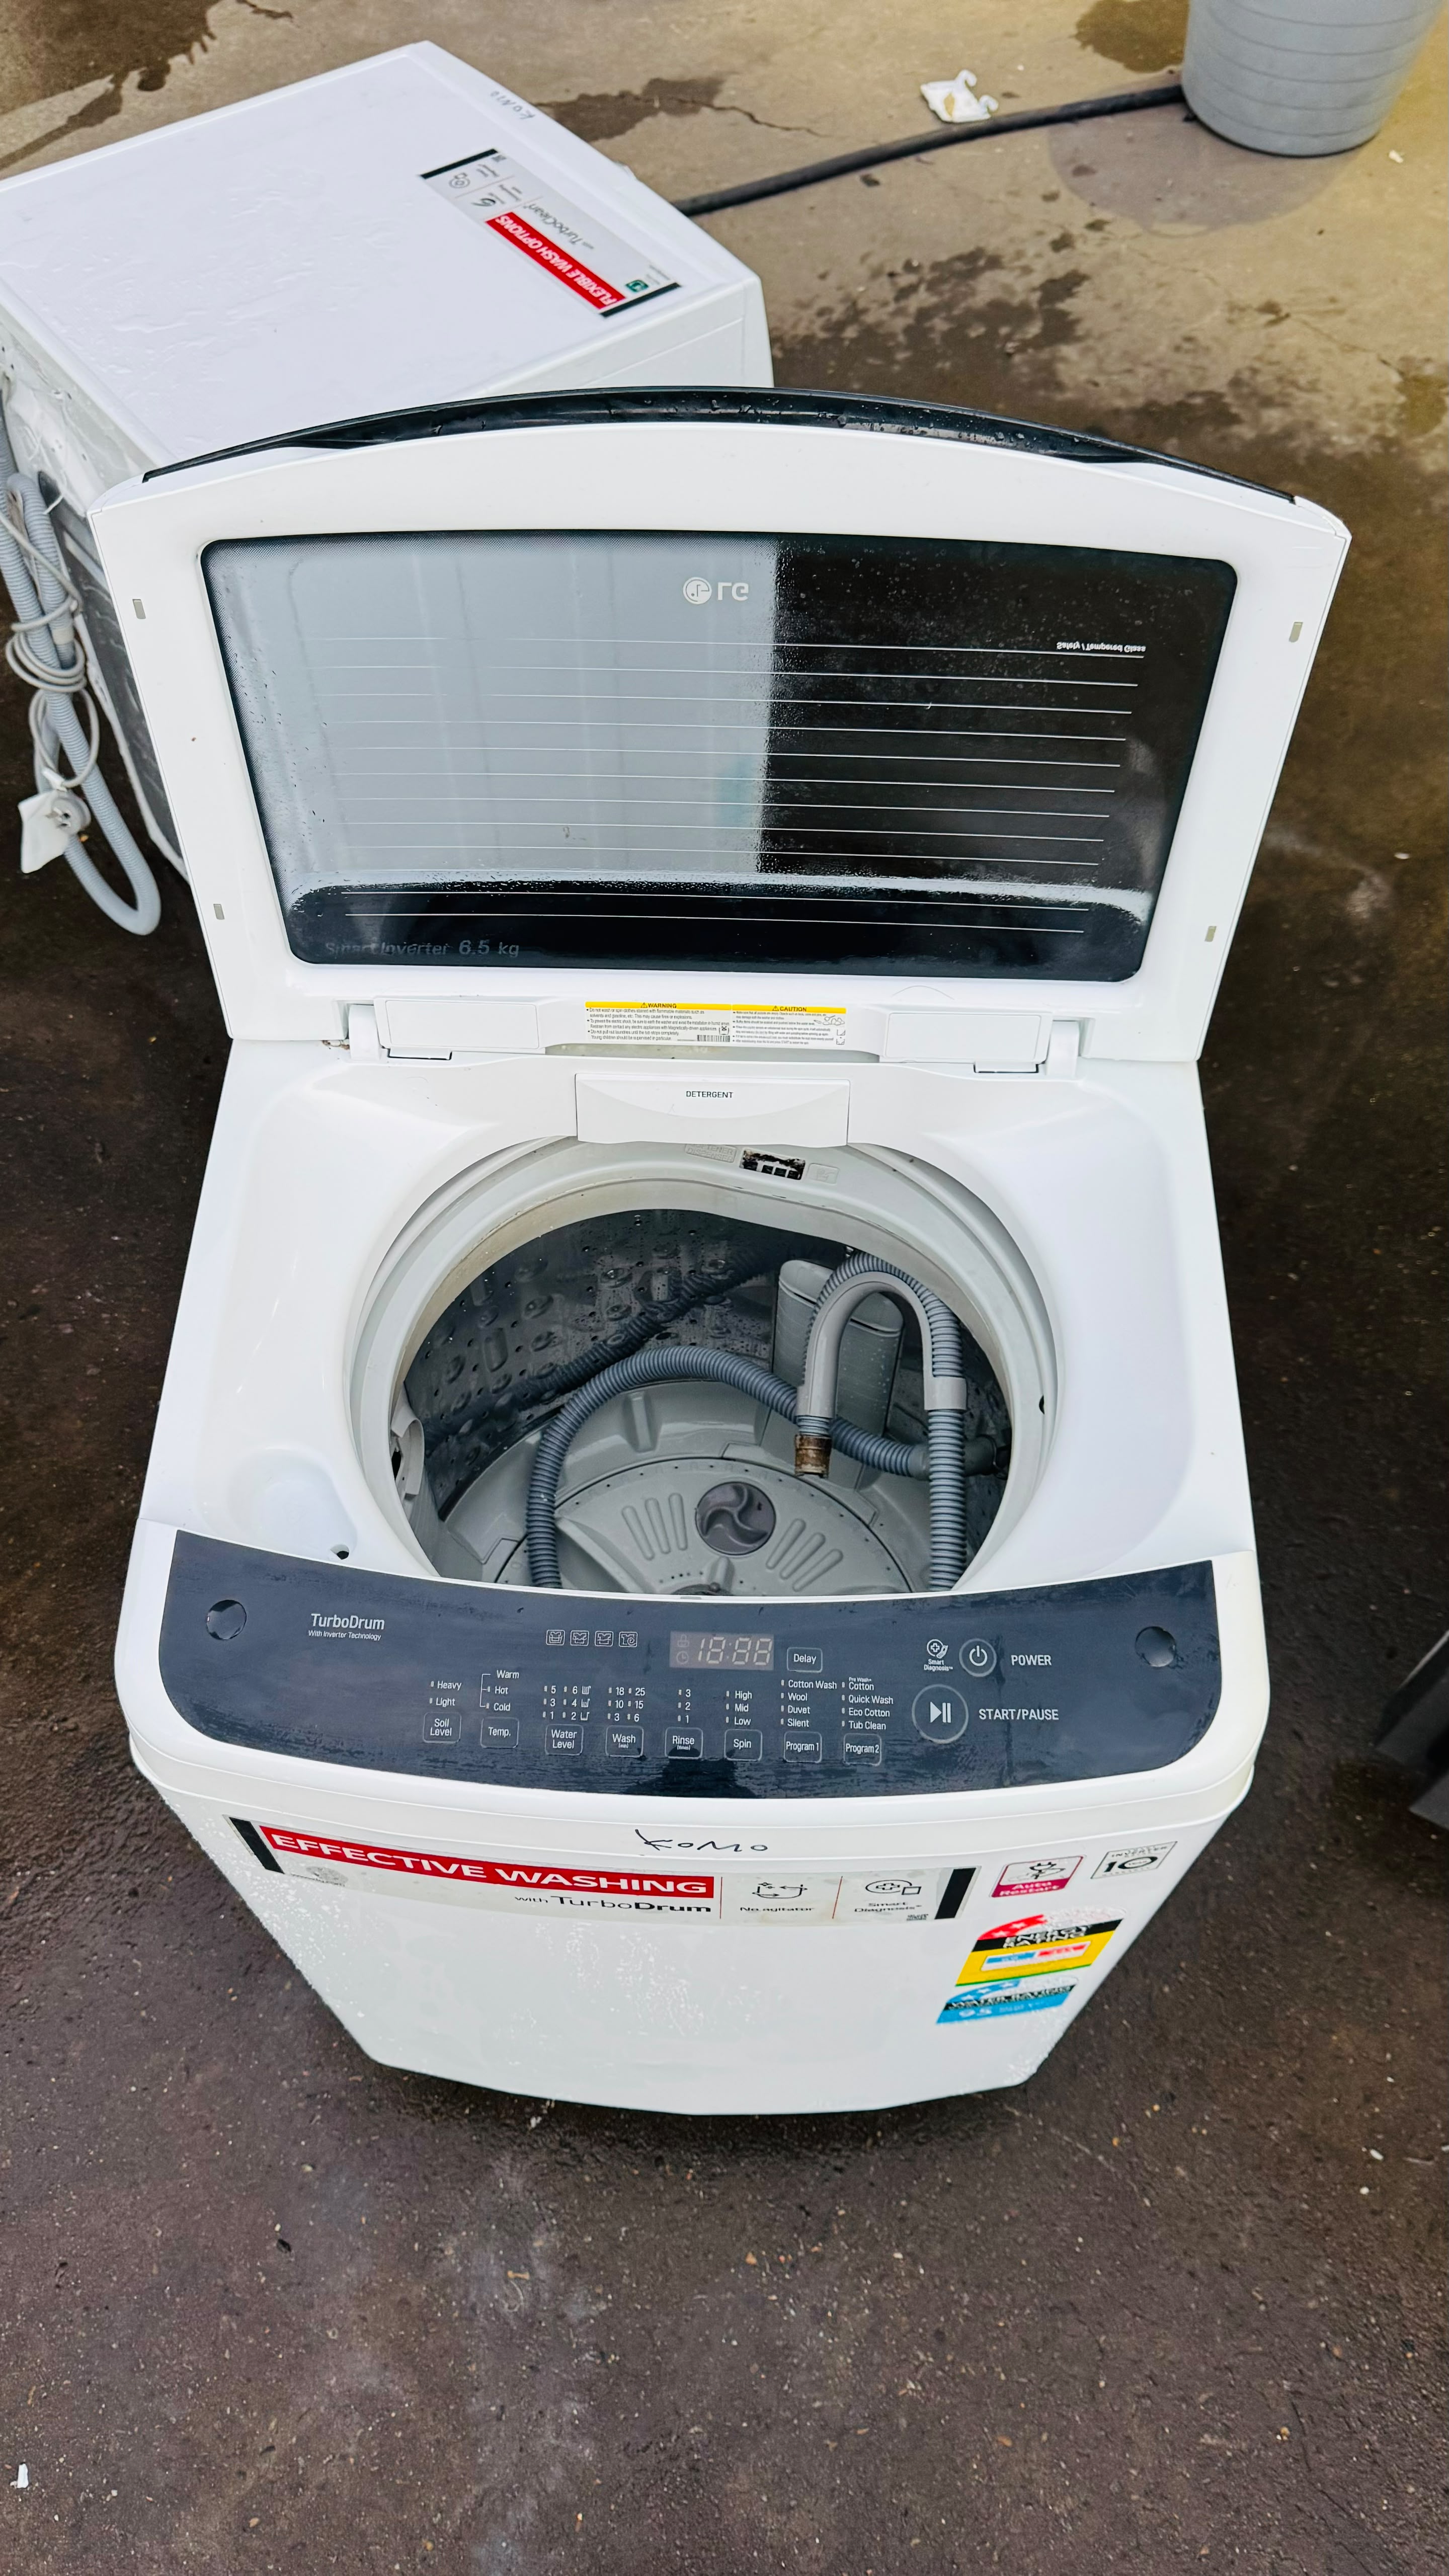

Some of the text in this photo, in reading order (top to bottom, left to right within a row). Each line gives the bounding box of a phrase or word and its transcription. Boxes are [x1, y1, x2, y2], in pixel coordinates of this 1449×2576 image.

[494, 214, 546, 250] OPTIONS
[534, 246, 574, 271] WASH
[565, 269, 618, 305] FLEXIBLE
[380, 941, 449, 955] Inverter
[459, 939, 490, 955] 6.5
[499, 941, 519, 957] kg
[686, 1090, 734, 1098] DETERGENT
[311, 1613, 385, 1630] TurboDrum
[323, 1631, 347, 1639] Inverter
[348, 1632, 381, 1641] Technology
[793, 1653, 817, 1664] Delay
[1011, 1654, 1052, 1666] POWER
[496, 1670, 519, 1679] Warm
[437, 1680, 462, 1691] Heavy
[788, 1679, 837, 1690] Cotton Wash
[849, 1681, 874, 1691] Cotton
[495, 1686, 508, 1695] Hot
[550, 1685, 578, 1694] 5 6
[616, 1687, 646, 1696] 18 25
[685, 1689, 691, 1698] 3
[735, 1691, 752, 1701] High
[788, 1693, 808, 1702] Wool
[848, 1695, 894, 1705] Quick Wash
[436, 1698, 455, 1707] Light
[550, 1699, 577, 1707] 3 4
[615, 1700, 643, 1709] 10 15
[685, 1702, 691, 1711] 2
[494, 1703, 511, 1712] Cold
[735, 1704, 749, 1712] Mid
[788, 1705, 811, 1714] Duvet
[550, 1711, 577, 1720] 1 2
[849, 1708, 890, 1717] Eco Cotton
[979, 1708, 1059, 1720] START/PAUSE
[614, 1713, 639, 1722] 3 6
[685, 1715, 689, 1724] 1
[734, 1717, 751, 1726] Low
[434, 1719, 449, 1727] Soil
[787, 1718, 810, 1727] Silent
[848, 1721, 887, 1730] Tub Clean
[430, 1728, 452, 1736] Level
[488, 1727, 511, 1738] Temp.
[551, 1729, 577, 1739] Water
[612, 1734, 636, 1743] Wash
[672, 1735, 695, 1745] Rinse
[552, 1740, 575, 1749] Level
[733, 1739, 752, 1749] Spin
[271, 1833, 707, 1894] EFFECTIVE WASHING
[999, 1885, 1060, 1896] Restart
[1011, 1882, 1052, 1890] Auto
[550, 1895, 711, 1912] TurboDrum
